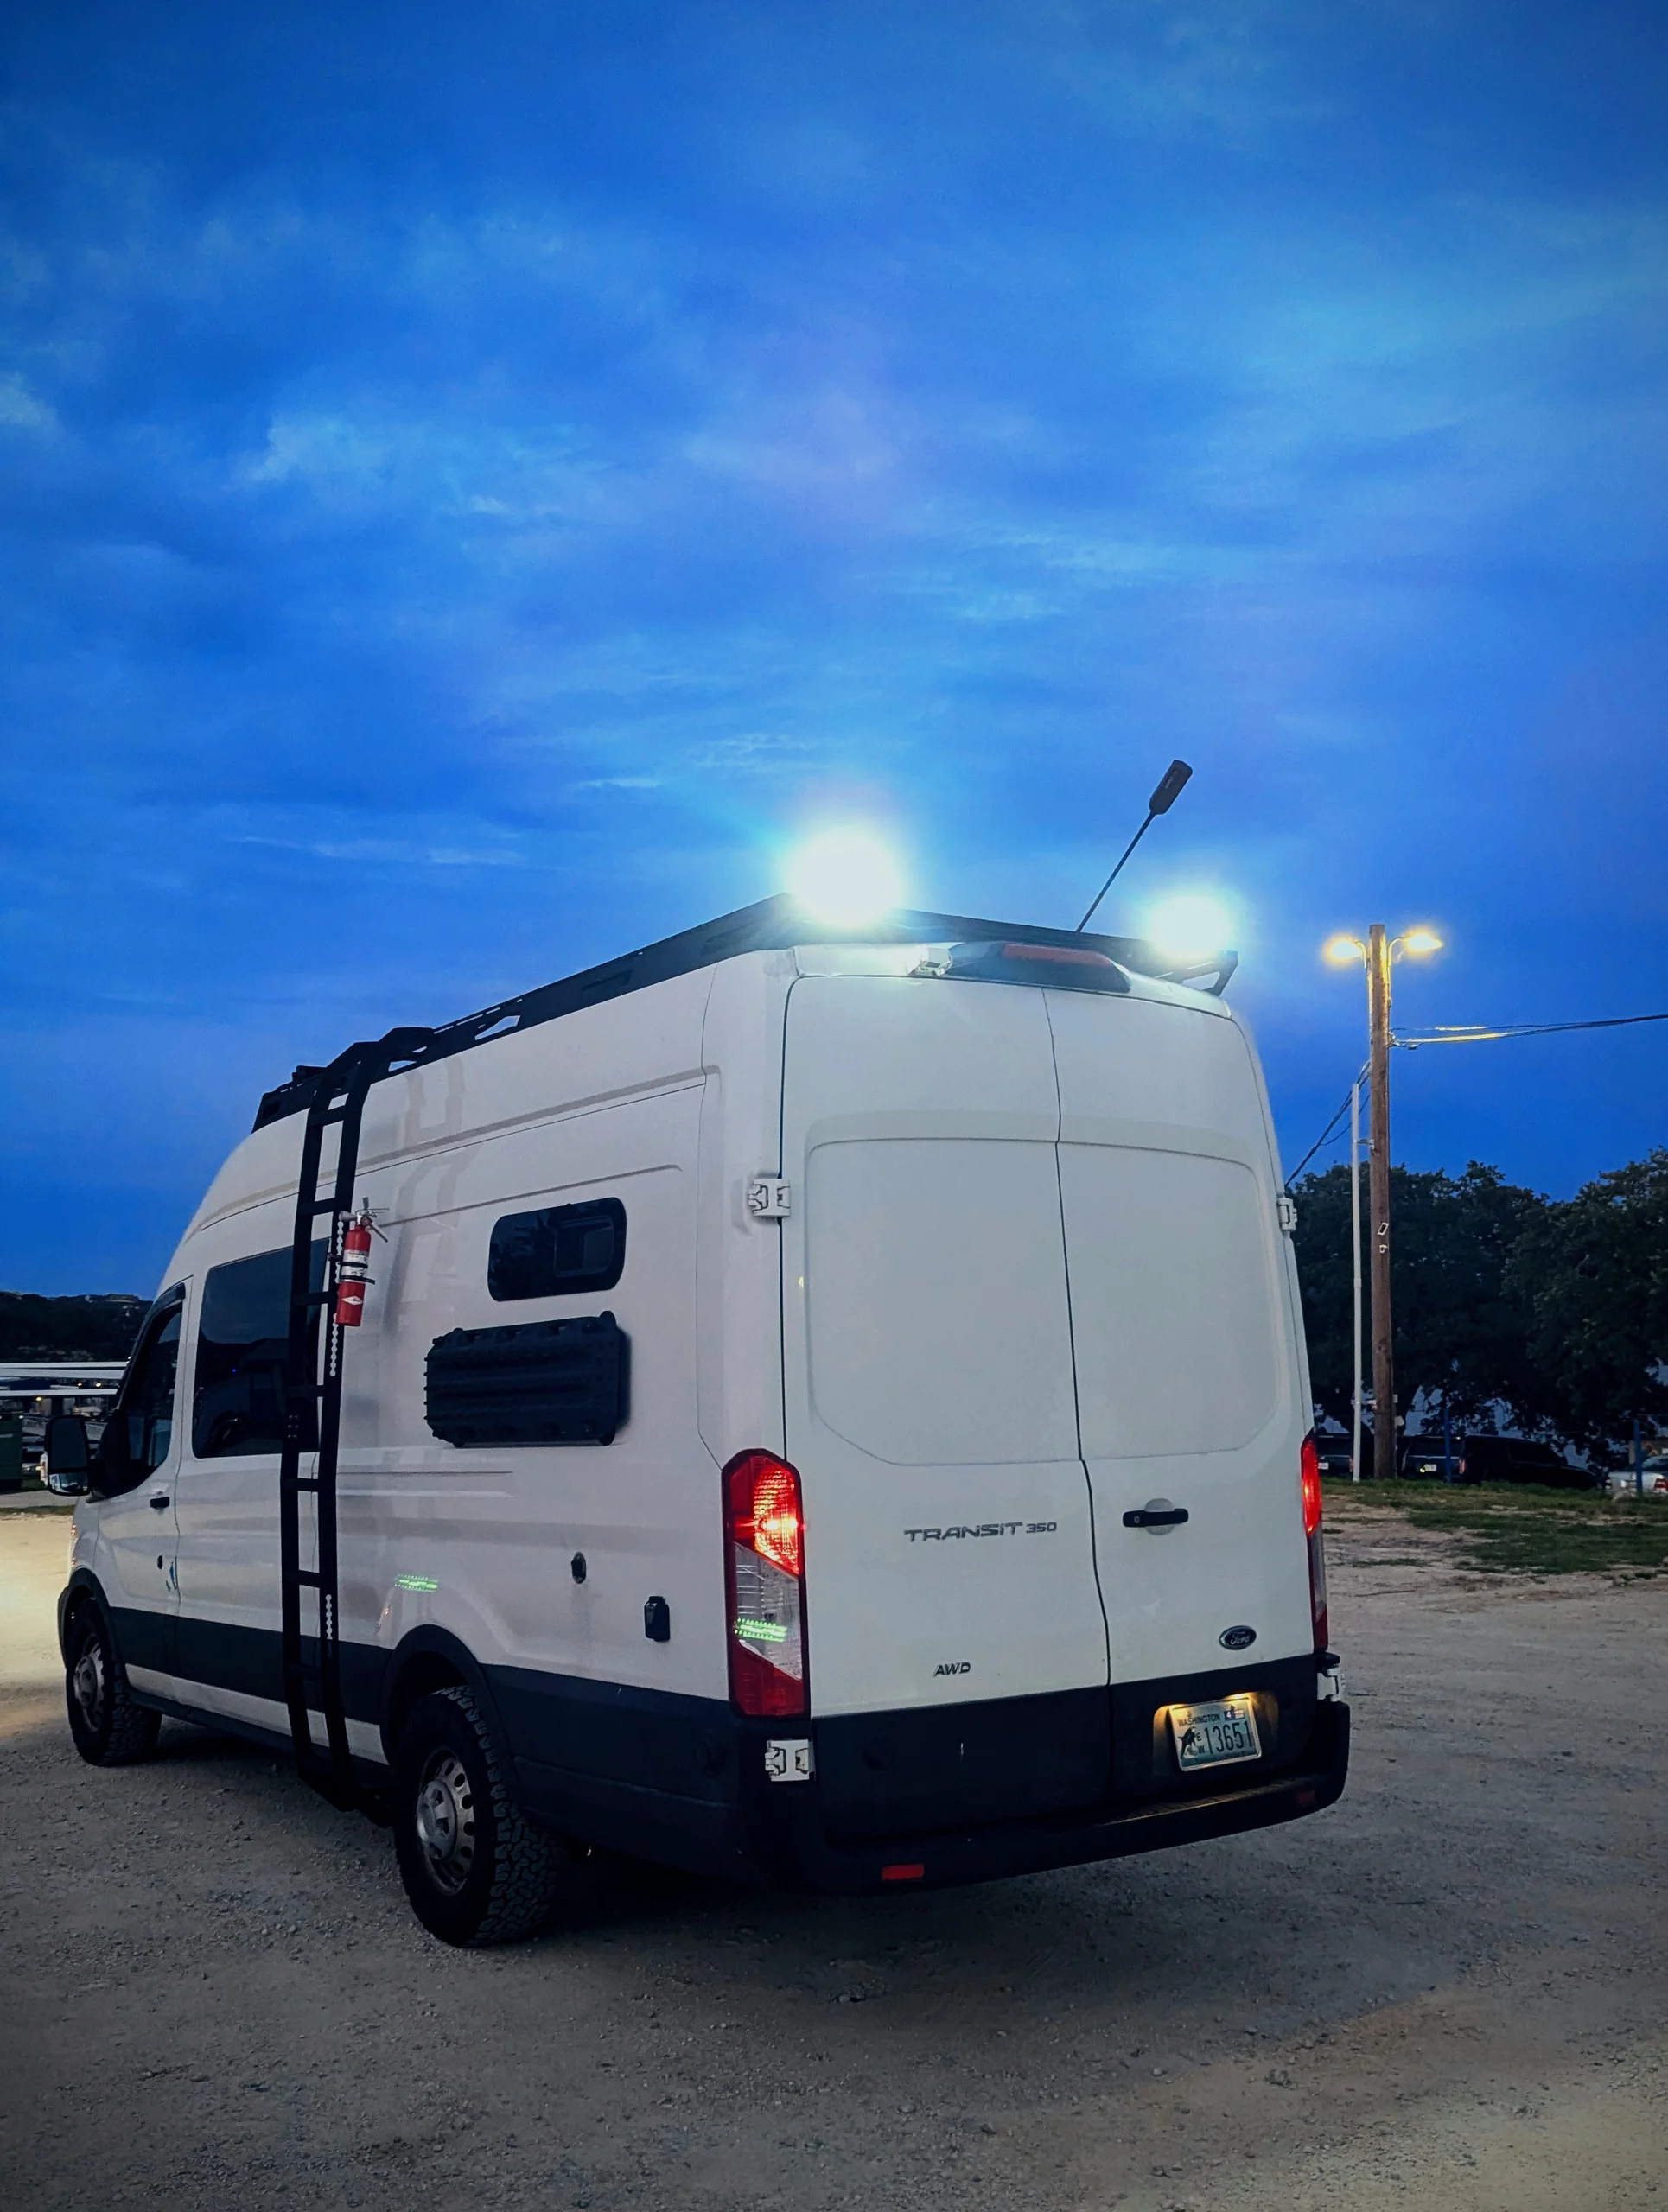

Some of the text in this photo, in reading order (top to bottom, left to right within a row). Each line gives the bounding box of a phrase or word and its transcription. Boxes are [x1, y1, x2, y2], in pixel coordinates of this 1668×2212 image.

[904, 1522, 1057, 1542] TRANSIT 350
[933, 1662, 971, 1677] AWD
[1177, 1713, 1220, 1727] WASHINGTON
[1205, 1720, 1252, 1755] 13651
